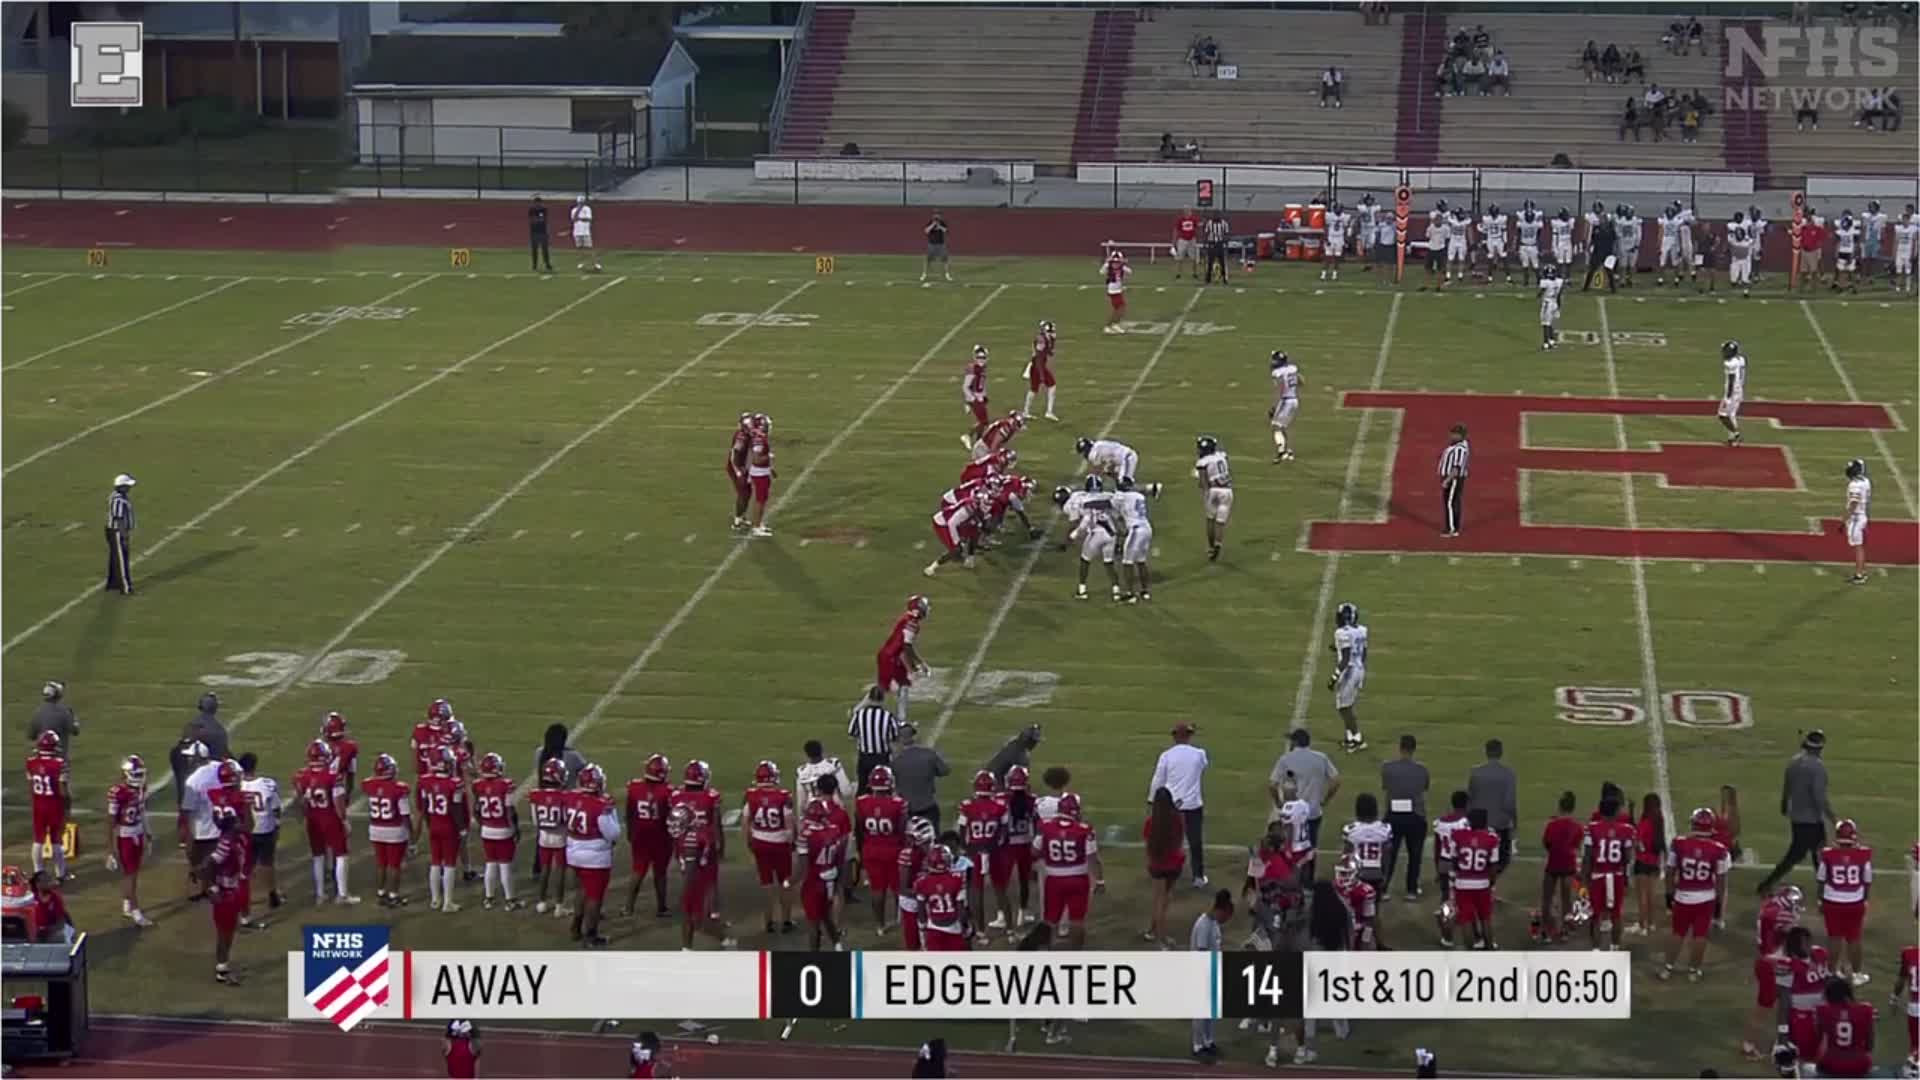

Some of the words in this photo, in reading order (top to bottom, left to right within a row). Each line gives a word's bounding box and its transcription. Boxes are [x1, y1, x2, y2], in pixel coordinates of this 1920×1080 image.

[1199, 181, 1211, 198] 2
[453, 250, 467, 265] 20
[817, 257, 832, 273] 30
[199, 649, 404, 687] 30
[1554, 685, 1755, 729] 50
[32, 776, 54, 795] 81
[369, 797, 393, 819] 52
[427, 794, 448, 815] 13
[480, 796, 504, 818] 23
[567, 808, 588, 834] 73
[754, 807, 781, 828] 46
[865, 818, 893, 836] 90
[971, 821, 997, 839] 80
[1048, 839, 1077, 862] 65
[1458, 847, 1488, 872] 36
[1681, 857, 1711, 881] 56
[929, 895, 954, 913] 31
[1837, 1021, 1853, 1046] 9
